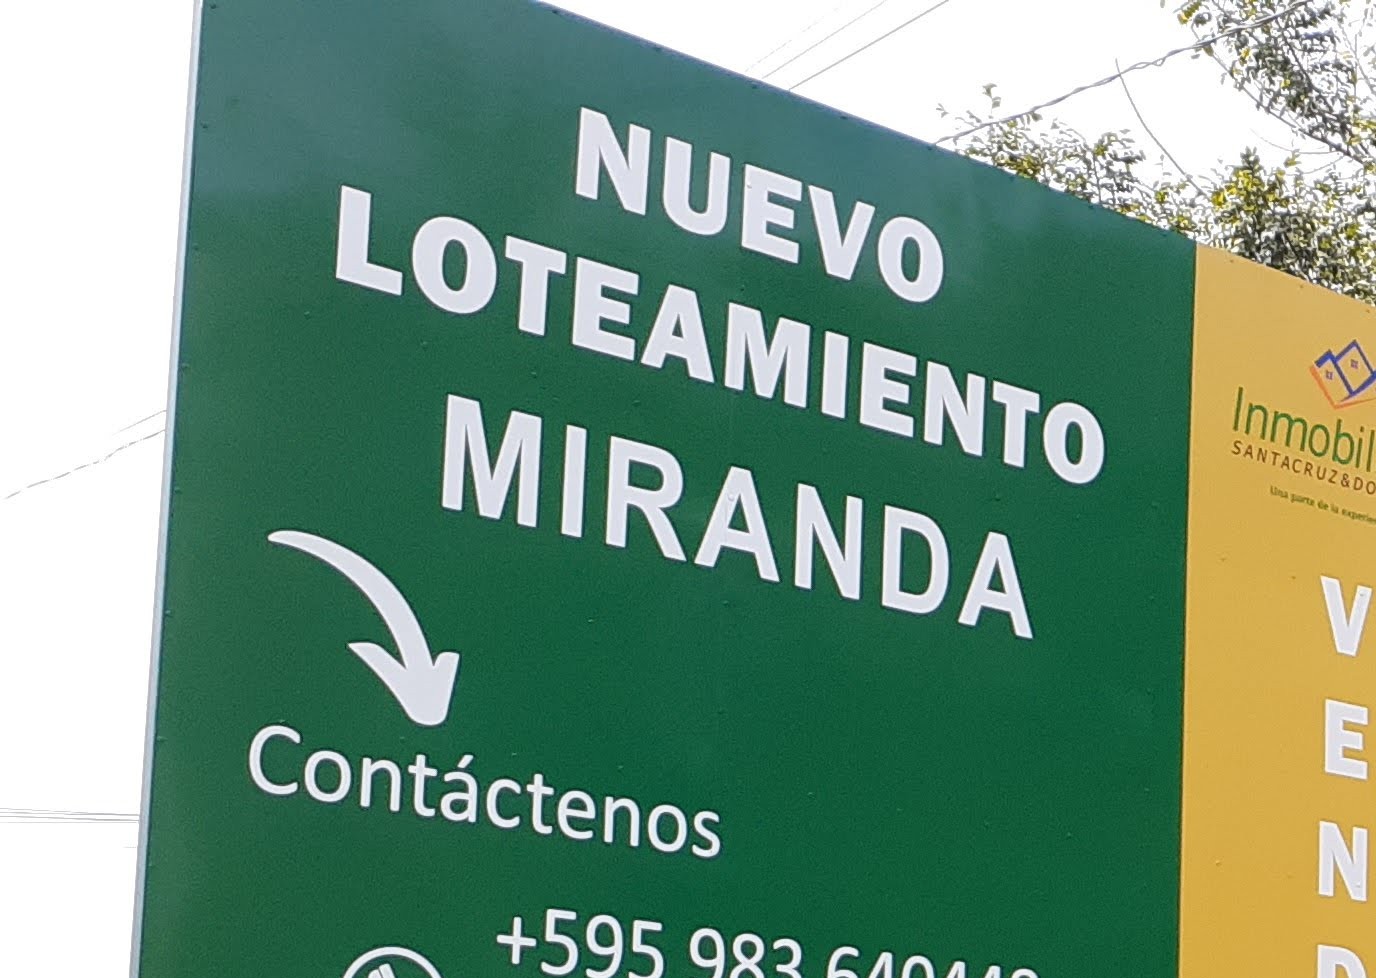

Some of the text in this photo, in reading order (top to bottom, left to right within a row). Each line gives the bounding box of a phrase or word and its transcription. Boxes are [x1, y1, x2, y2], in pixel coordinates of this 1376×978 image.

[576, 107, 943, 302] NUEVO
[336, 186, 1104, 483] LOTEAMIENTO
[442, 395, 1032, 638] MIRANDA
[249, 726, 721, 857] Contáctenos
